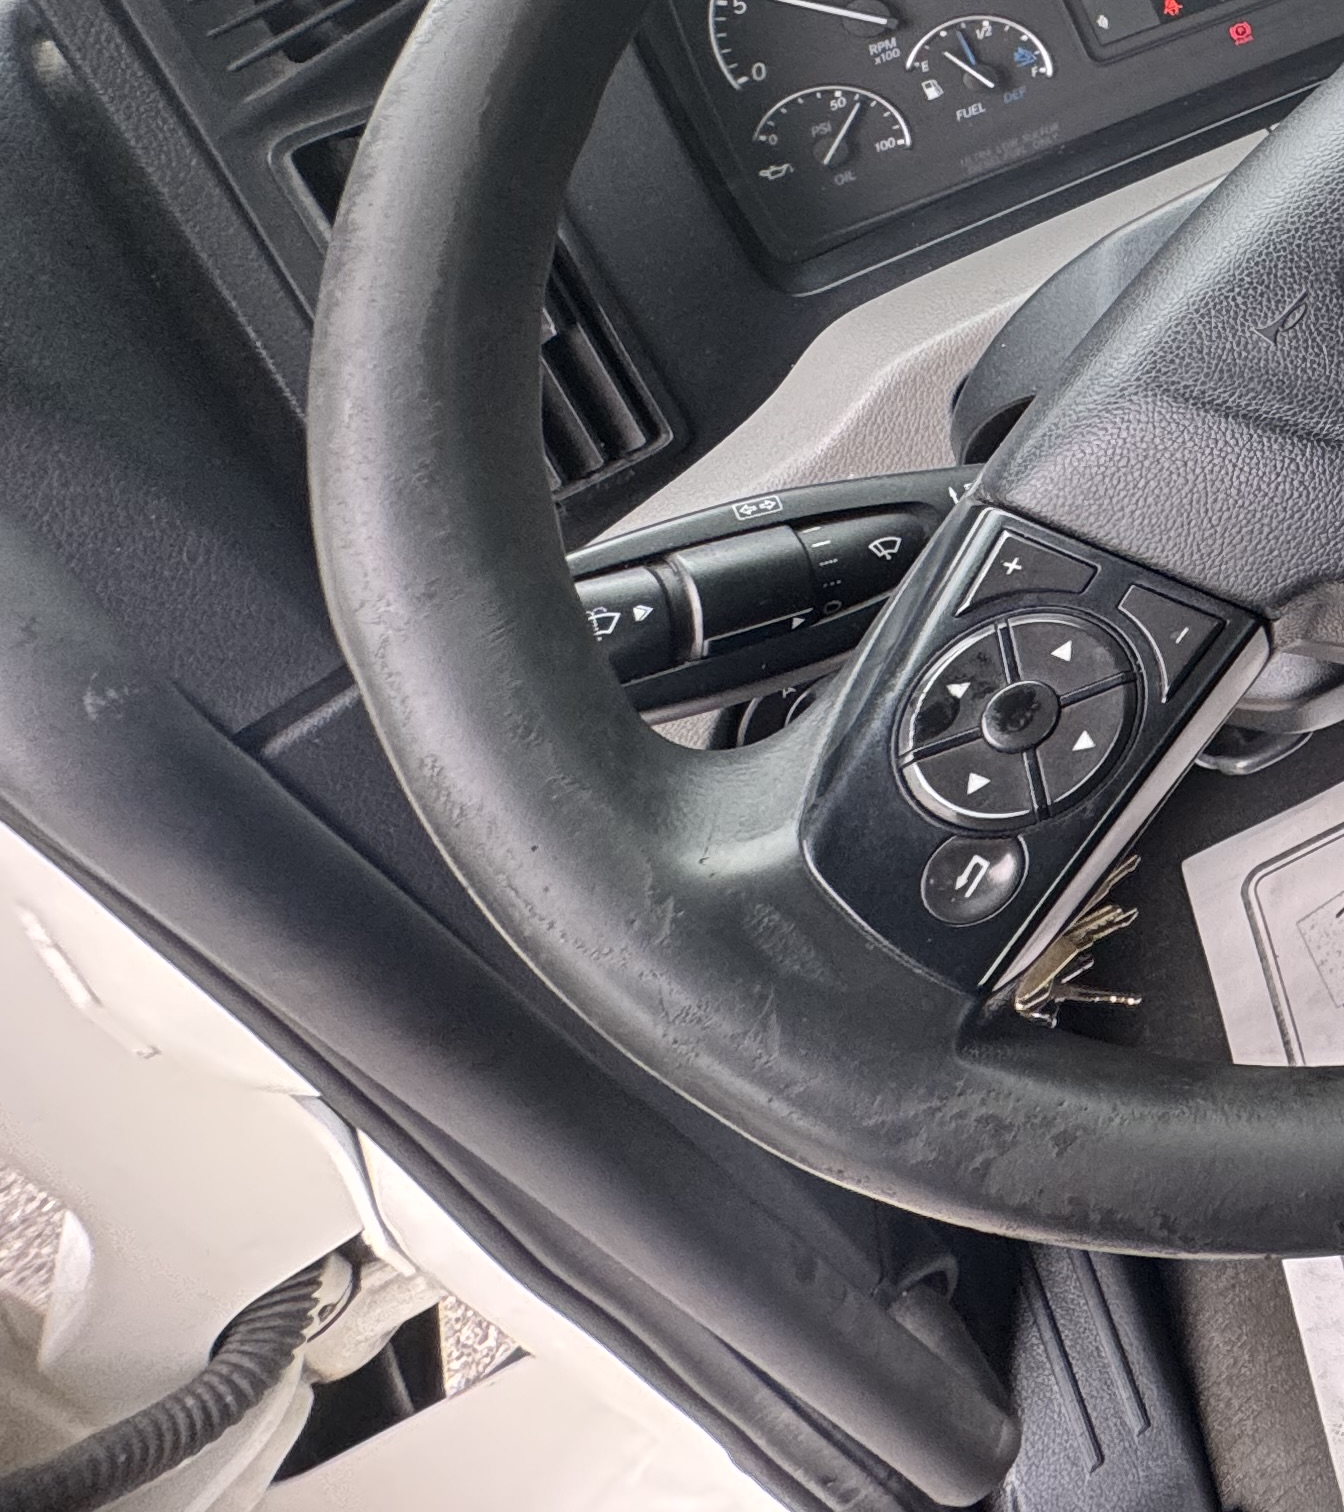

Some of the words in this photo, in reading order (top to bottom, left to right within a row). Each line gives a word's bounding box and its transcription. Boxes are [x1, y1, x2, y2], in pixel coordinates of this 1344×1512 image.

[868, 37, 898, 56] RPM
[874, 48, 901, 65] x100
[751, 62, 767, 81] 0
[920, 61, 929, 74] E
[1031, 66, 1041, 78] F
[829, 96, 847, 111] 50
[956, 102, 987, 122] FUEL
[811, 121, 833, 139] PSI
[873, 136, 898, 154] 100
[834, 170, 857, 186] OIL
